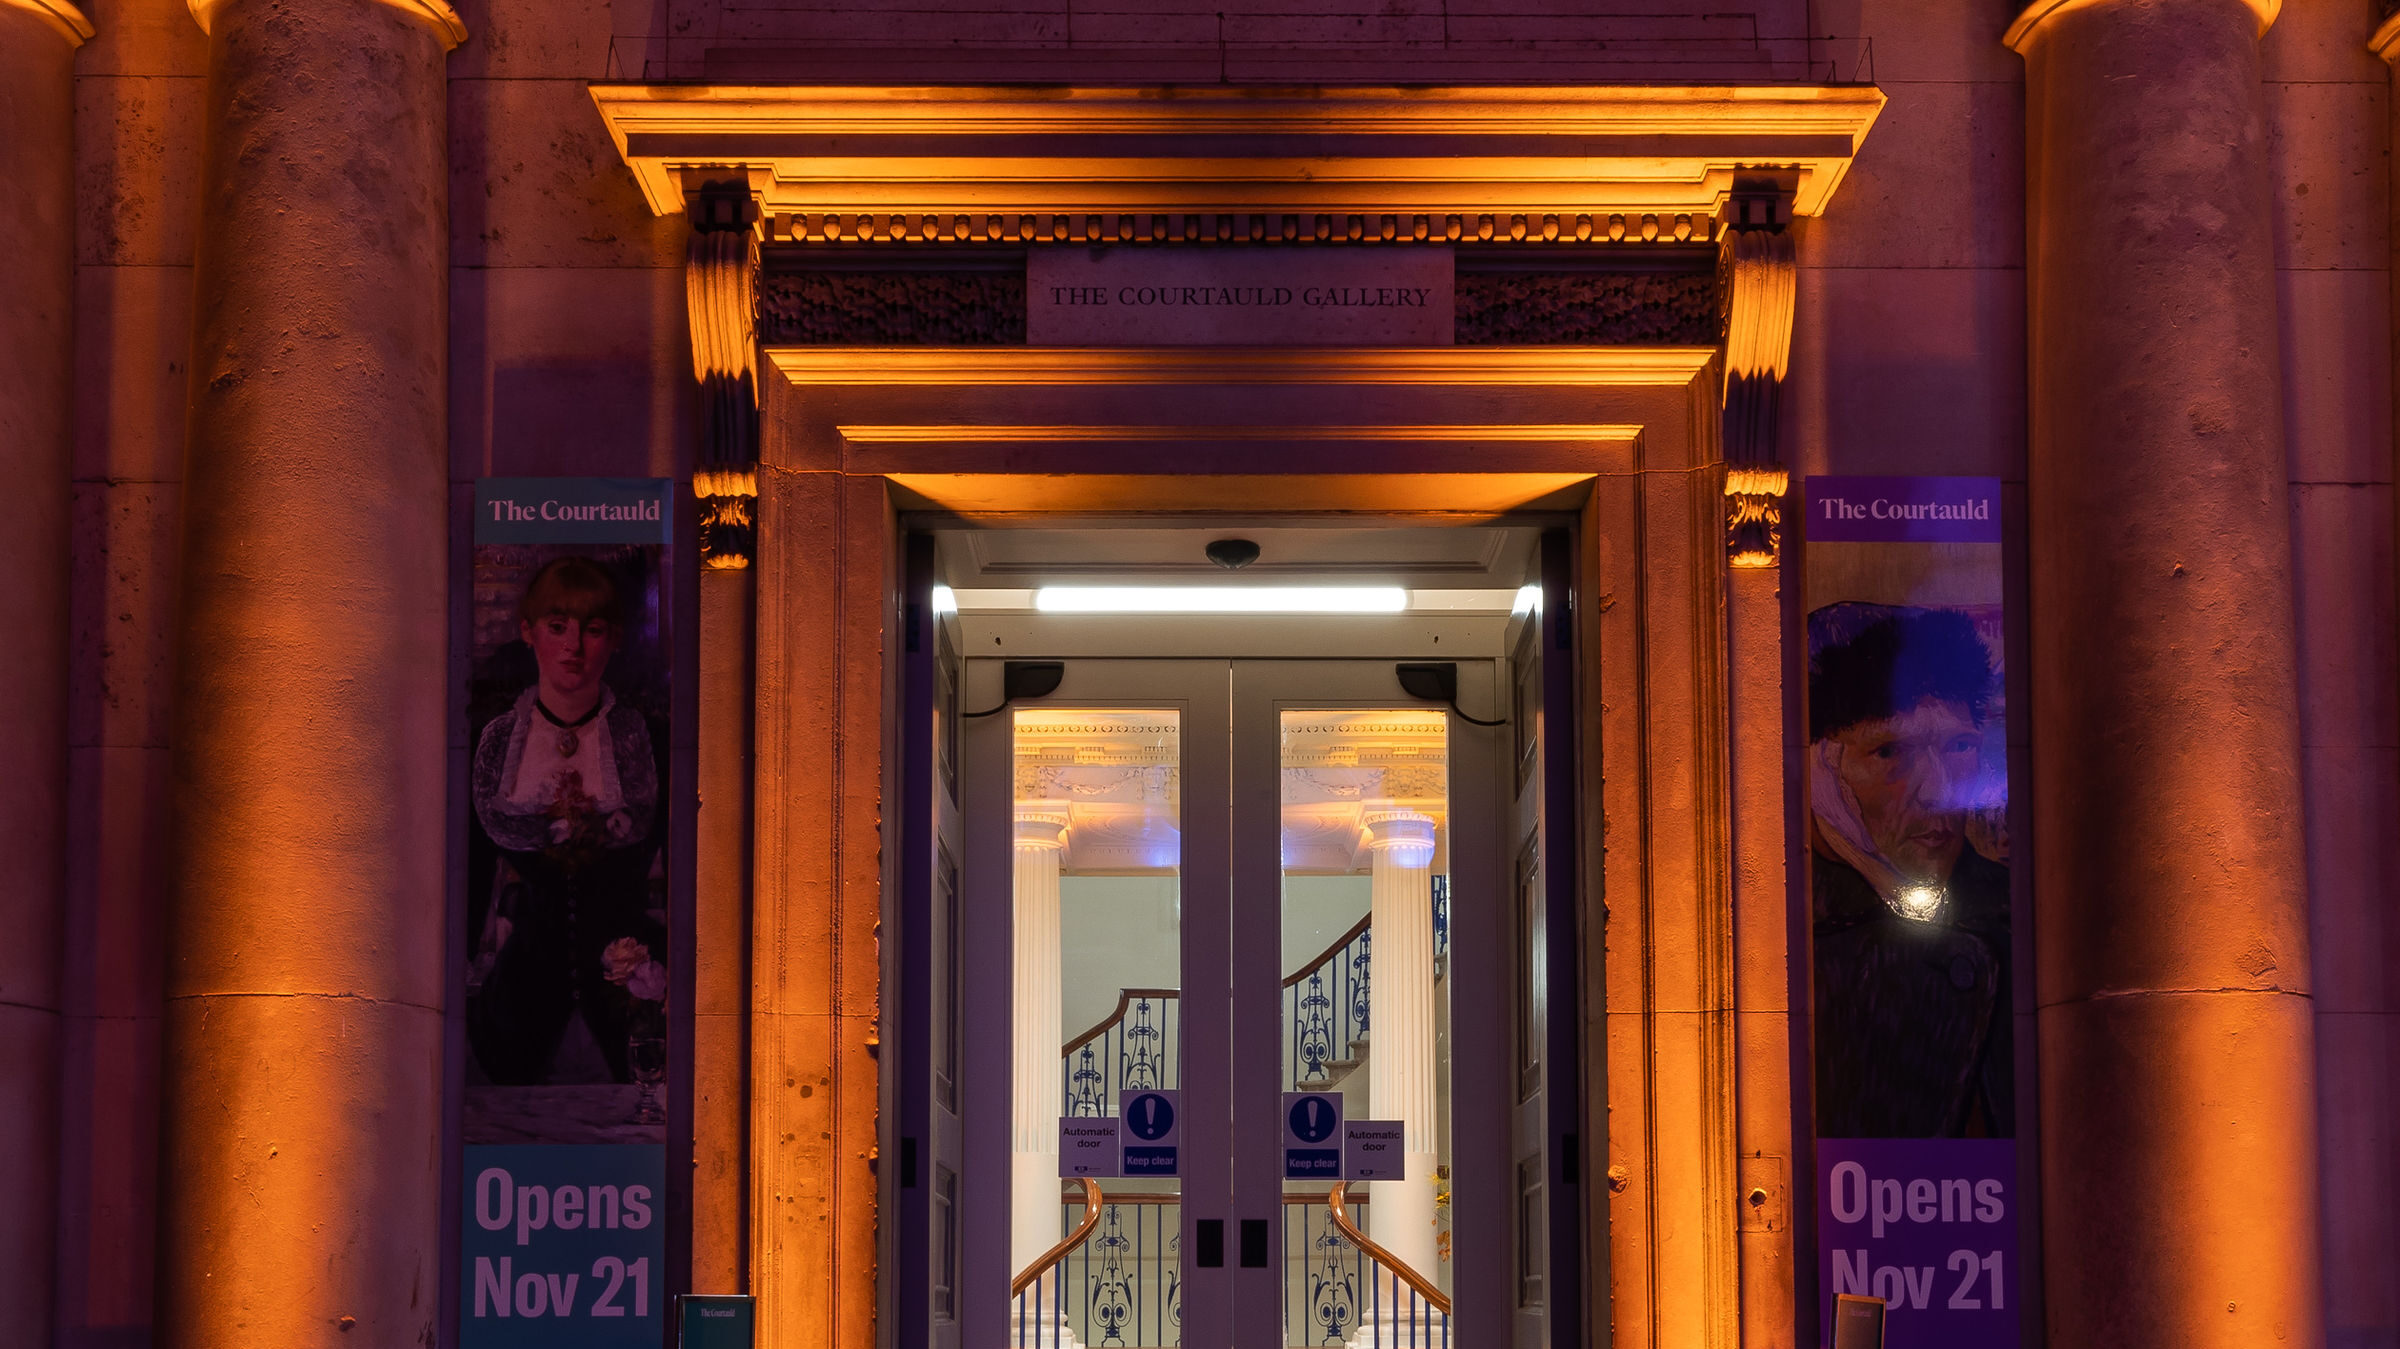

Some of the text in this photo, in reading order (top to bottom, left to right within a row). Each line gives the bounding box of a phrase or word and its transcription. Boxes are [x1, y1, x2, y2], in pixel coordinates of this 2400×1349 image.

[1050, 286, 1432, 308] THE COURTAULD GALLERY
[487, 500, 661, 521] The Courtauld
[1818, 498, 1989, 521] The Courtauld
[1063, 1127, 1115, 1137] Automatic
[1348, 1130, 1400, 1140] Automatic
[1077, 1139, 1102, 1148] door
[1362, 1142, 1387, 1151] door
[1126, 1155, 1174, 1167] Keep clear
[1289, 1158, 1337, 1169] Keep clear
[475, 1167, 652, 1246] Opens
[1829, 1160, 2005, 1239] Opens
[474, 1255, 649, 1318] Nov 21
[1832, 1249, 2004, 1311] Nov 21
